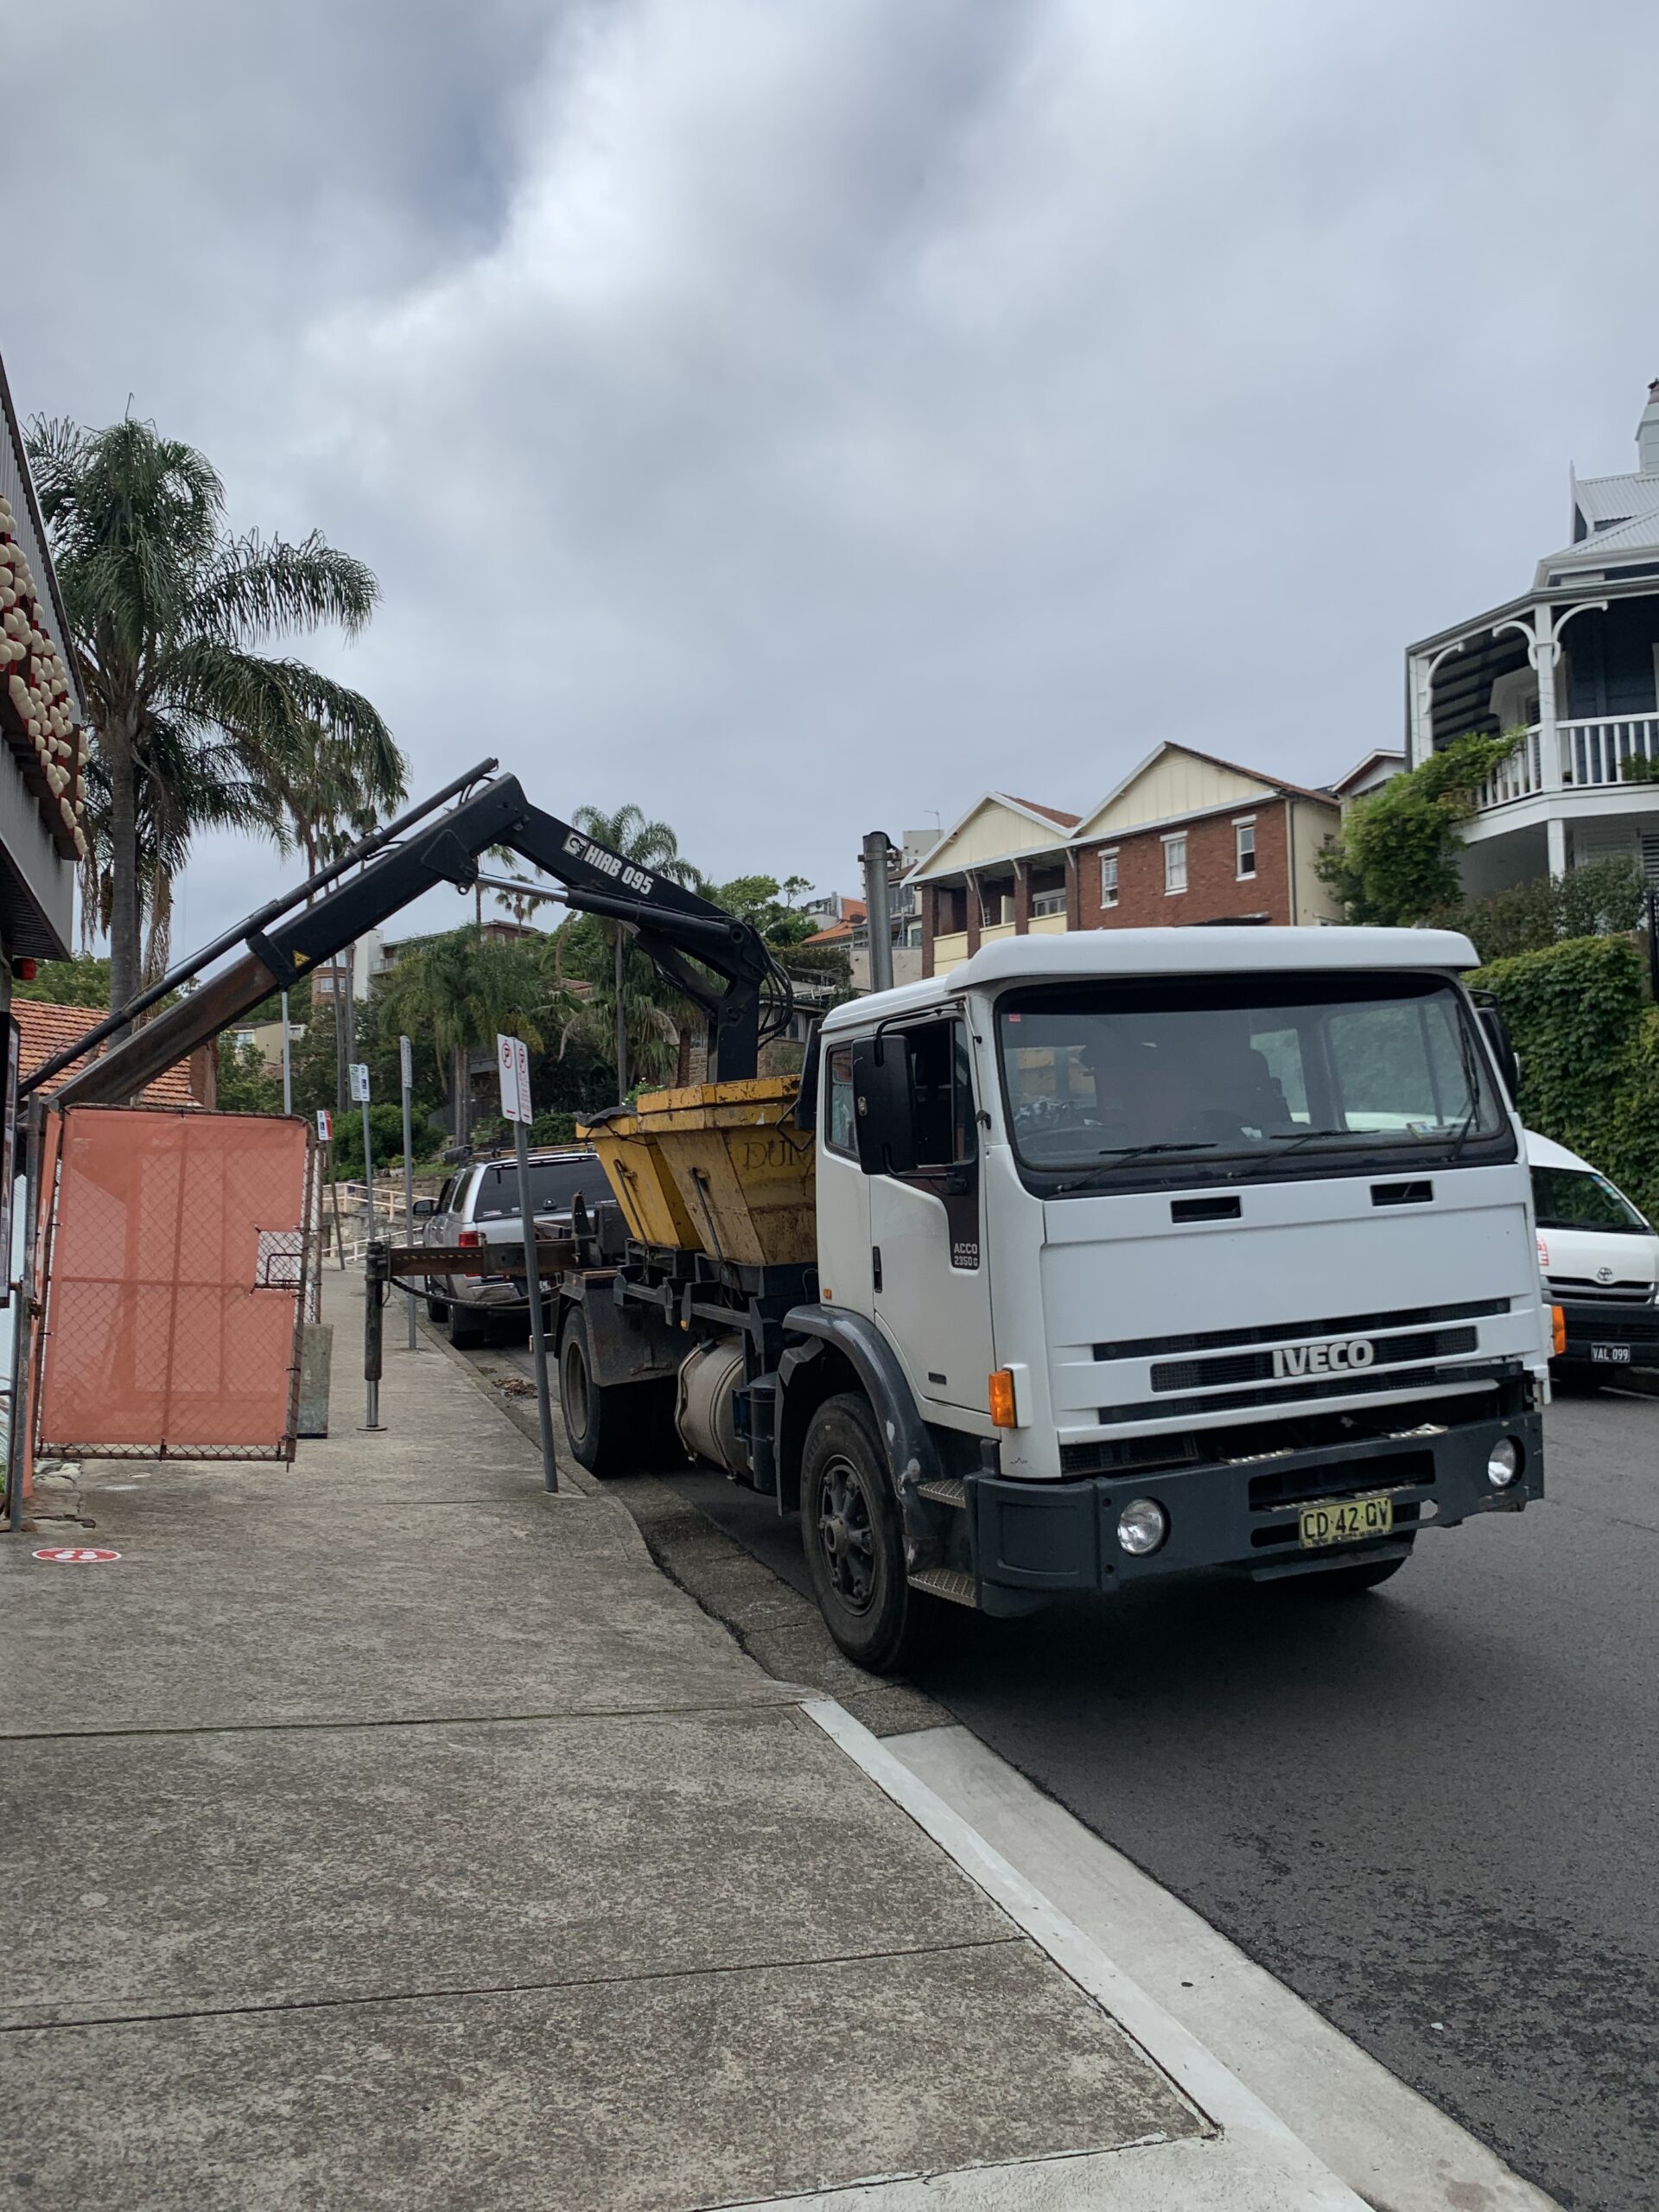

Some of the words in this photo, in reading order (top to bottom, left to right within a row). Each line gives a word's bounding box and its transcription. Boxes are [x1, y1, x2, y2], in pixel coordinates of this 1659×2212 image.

[584, 844, 623, 878] HIAB
[621, 866, 654, 895] 095
[954, 1243, 978, 1255] ACCO
[1272, 1339, 1374, 1378] IVECO
[1592, 1347, 1610, 1360] VAL
[1611, 1348, 1629, 1360] 099
